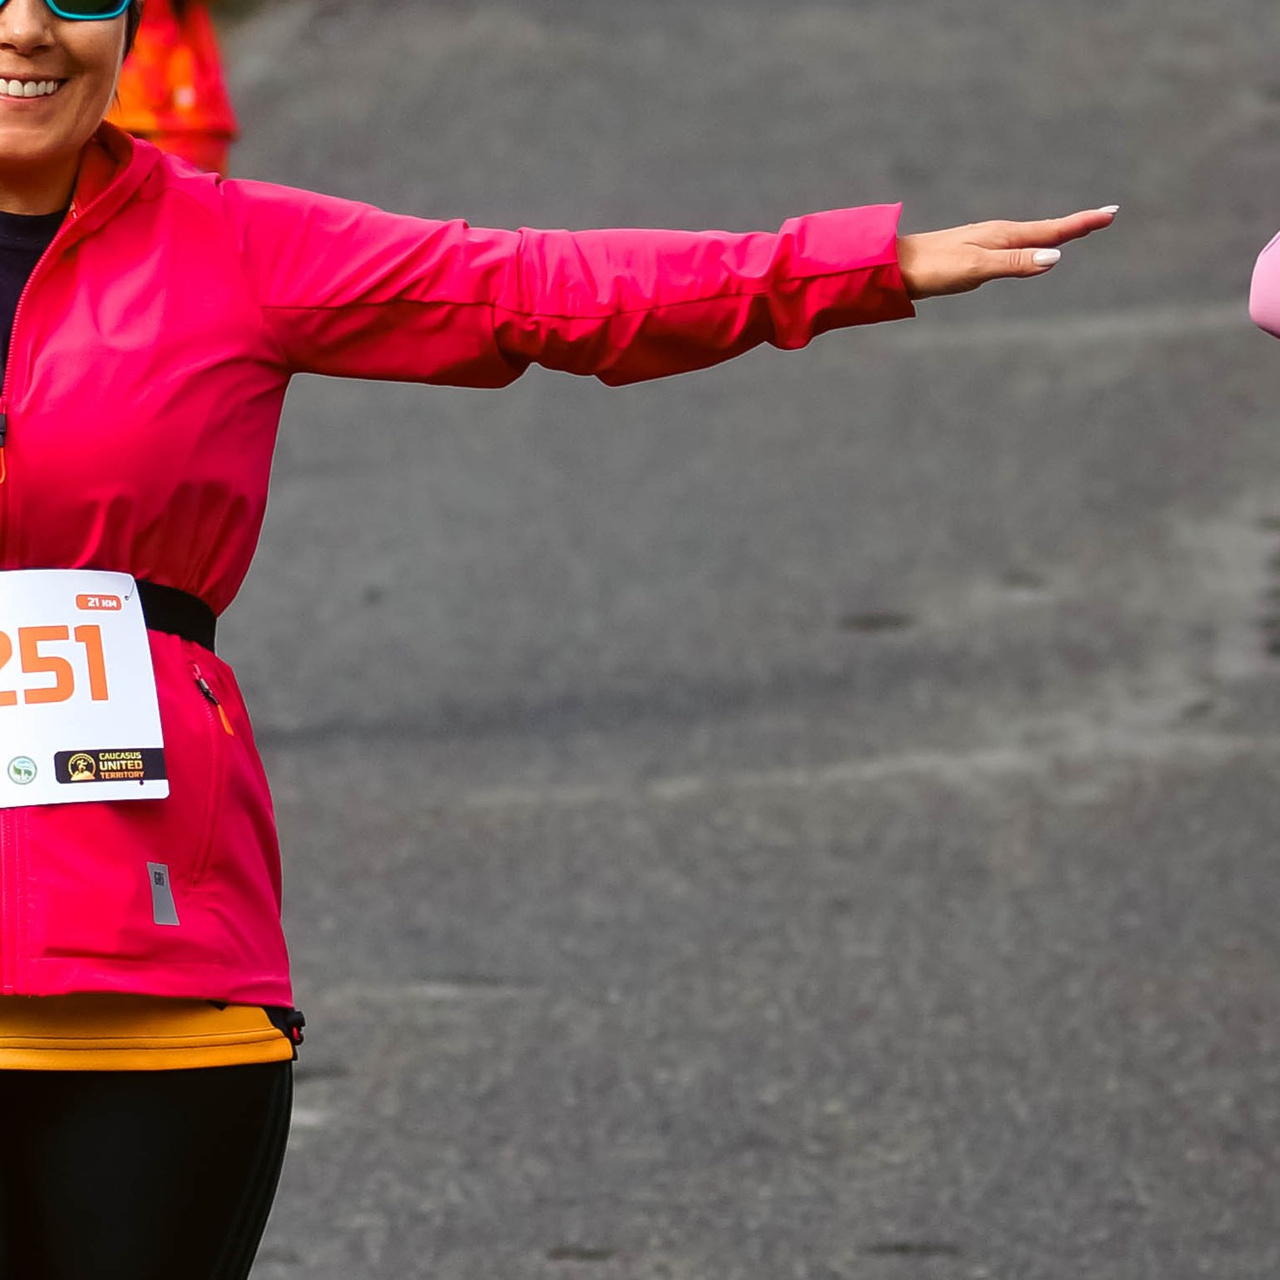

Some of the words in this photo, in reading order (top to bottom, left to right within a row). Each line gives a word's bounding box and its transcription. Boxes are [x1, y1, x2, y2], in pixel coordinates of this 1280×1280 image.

[87, 597, 100, 607] 21
[99, 751, 142, 760] CAUCASUS
[99, 760, 143, 771] UNITED
[101, 771, 144, 780] TERRITORY
